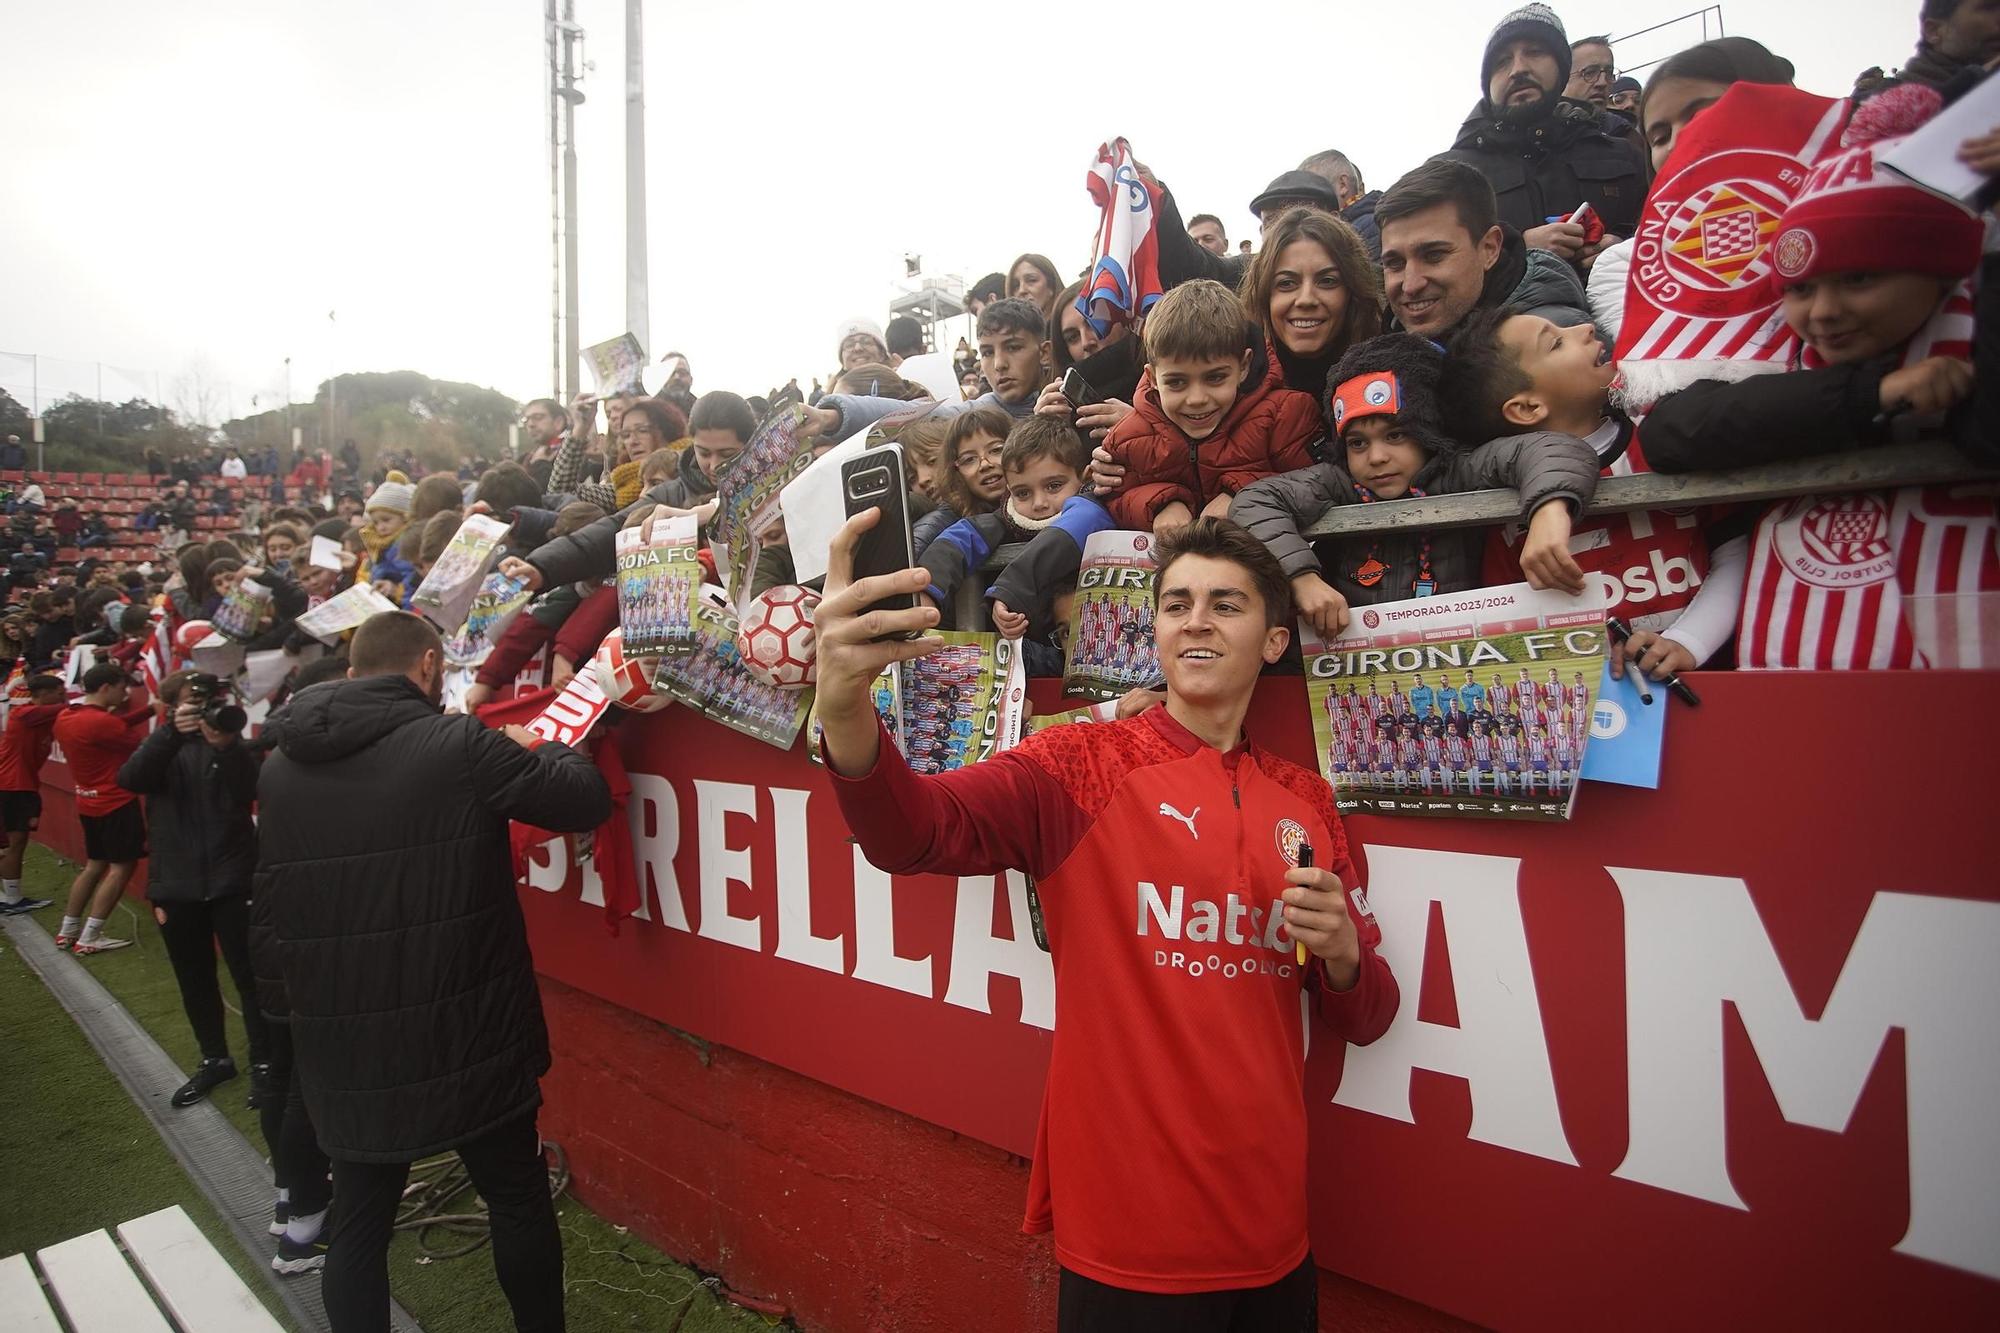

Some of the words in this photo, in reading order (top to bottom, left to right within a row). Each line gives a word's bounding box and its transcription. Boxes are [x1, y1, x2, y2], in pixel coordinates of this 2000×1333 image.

[1636, 200, 1681, 302] GIRONA
[667, 547, 696, 563] FC
[1080, 567, 1157, 589] GIR
[1385, 604, 1452, 622] TEMPORADA
[1454, 595, 1516, 613] 2023/2024
[1311, 641, 1508, 678] GIRONA
[1523, 630, 1600, 661] FC
[976, 638, 1012, 763] GIRON
[1009, 708, 1018, 745] TEMPOR
[1336, 801, 1358, 809] Gosbi
[517, 773, 1057, 1032] RELLA
[1303, 843, 2000, 1282] AM
